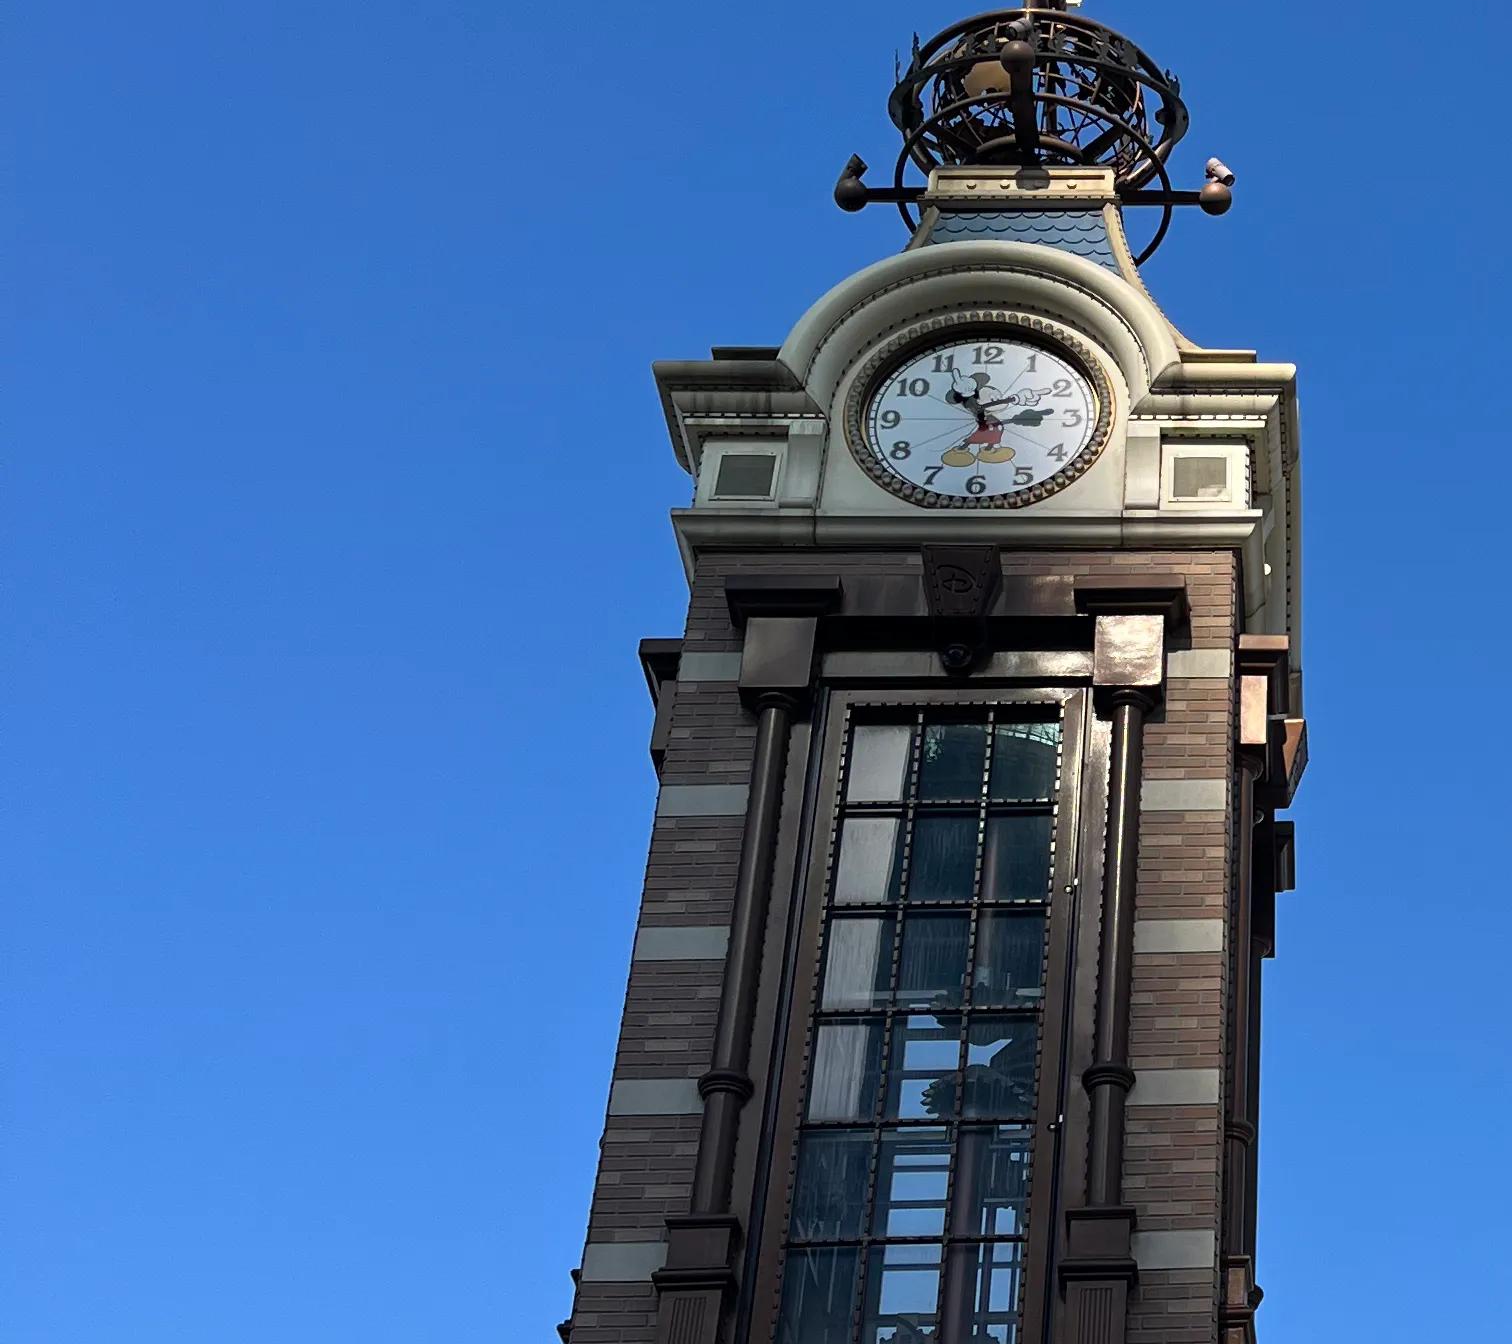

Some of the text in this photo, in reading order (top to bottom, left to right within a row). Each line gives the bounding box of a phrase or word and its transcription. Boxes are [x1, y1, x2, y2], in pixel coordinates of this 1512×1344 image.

[931, 354, 955, 373] 11
[972, 346, 1005, 364] 12
[1026, 354, 1038, 372] 1
[896, 377, 930, 397] 10
[1052, 379, 1073, 397] 2
[880, 410, 901, 429] 9
[1062, 409, 1082, 427] 3
[889, 441, 911, 460] 8
[1047, 443, 1067, 462] 4
[923, 466, 944, 486] 7
[965, 475, 987, 495] 6
[1012, 467, 1034, 486] 5
